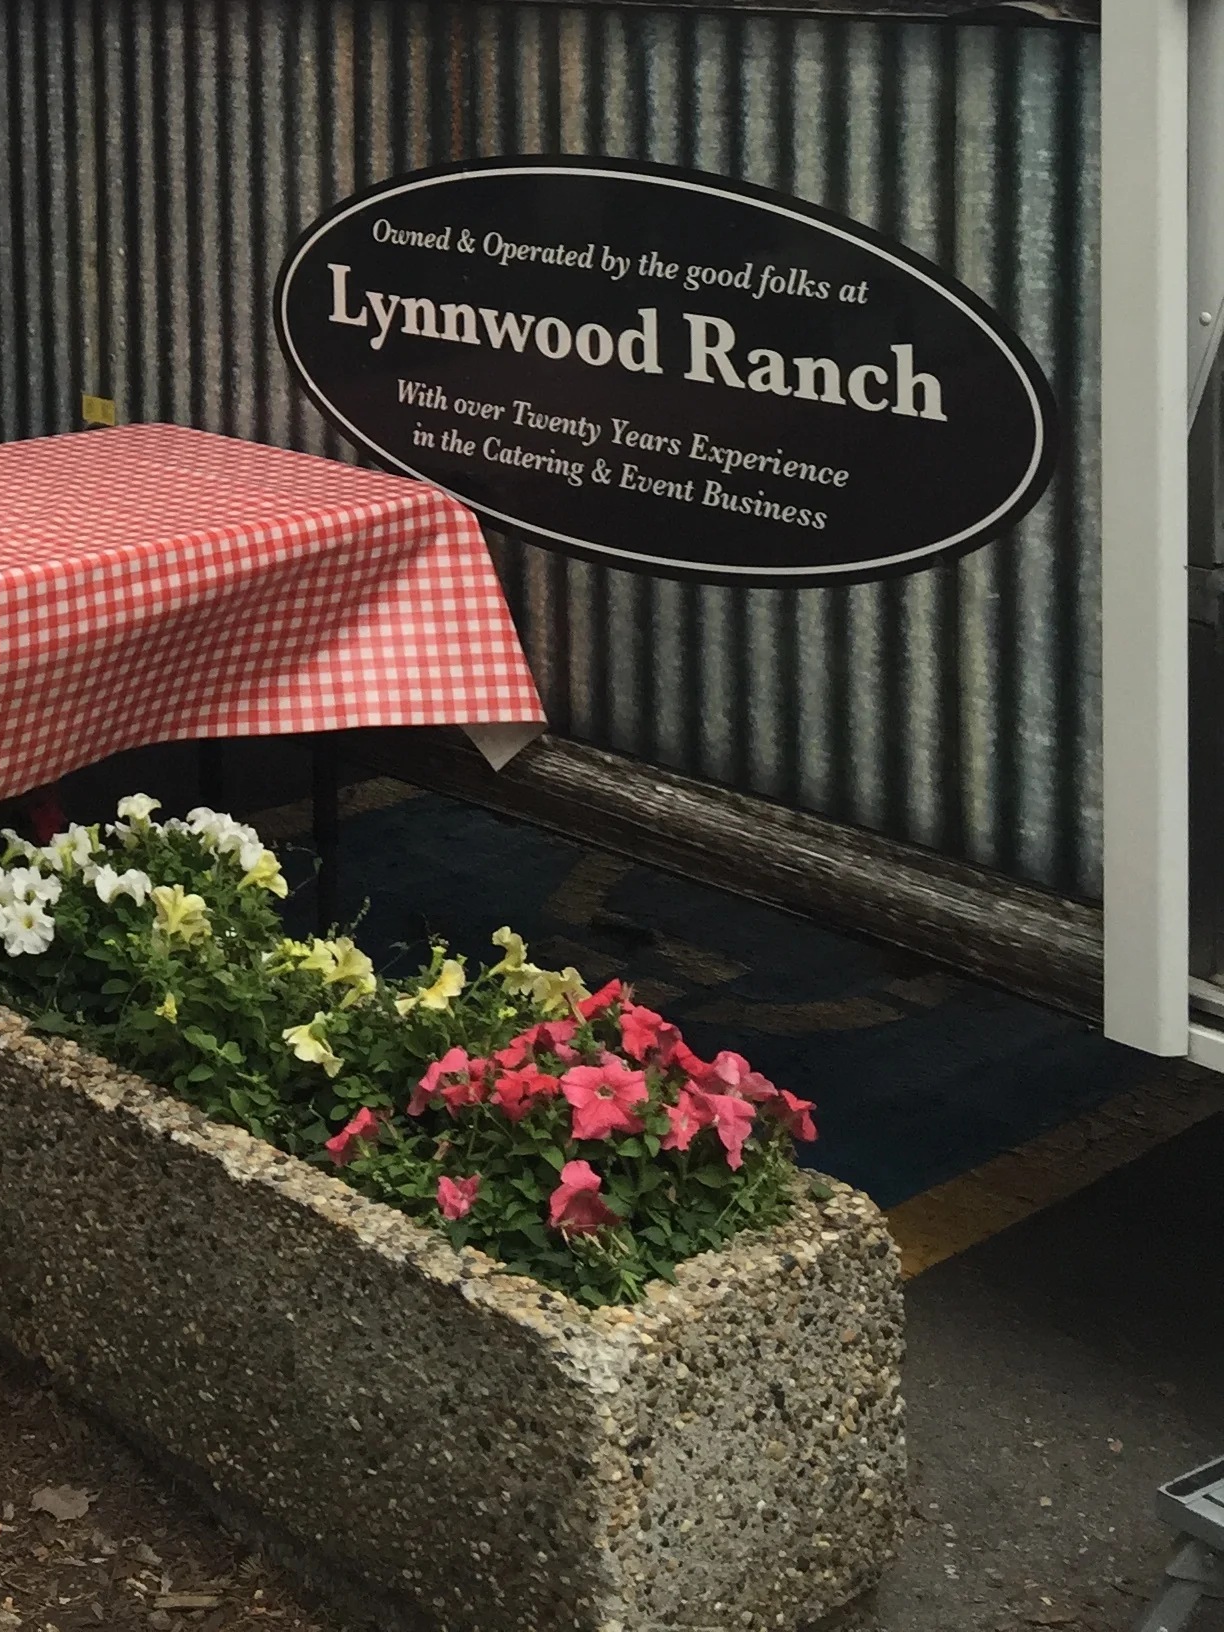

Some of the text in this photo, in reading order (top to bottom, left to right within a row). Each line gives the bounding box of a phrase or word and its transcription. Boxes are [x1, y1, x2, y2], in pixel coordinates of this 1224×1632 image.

[372, 218, 869, 305] Owned & Operated by the good folks at
[327, 263, 948, 422] Lynnwood Ranch
[397, 378, 850, 489] With over Twenty Years Experience
[413, 421, 828, 531] in the Catering & Event Business
